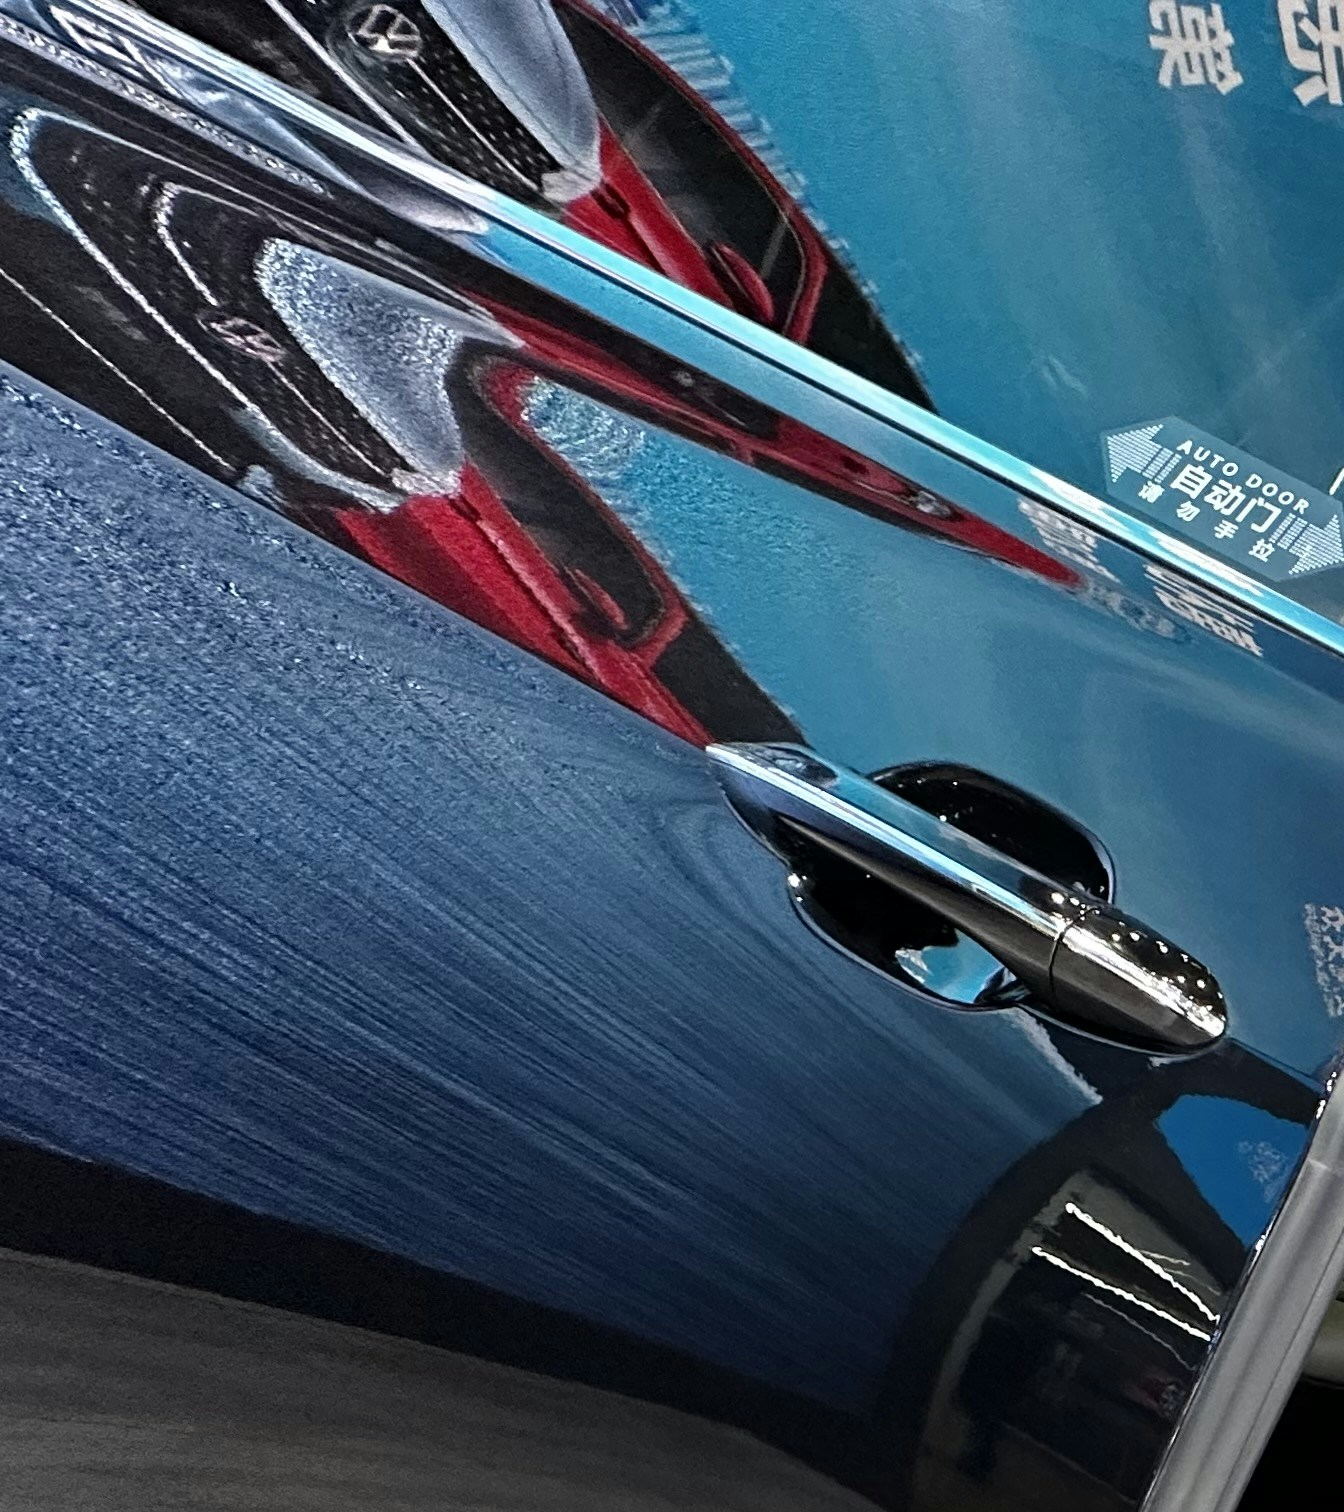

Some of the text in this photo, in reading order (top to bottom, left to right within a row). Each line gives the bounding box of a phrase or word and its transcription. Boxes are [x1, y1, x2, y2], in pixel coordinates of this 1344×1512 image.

[1170, 463, 1282, 533] 自动门
[1176, 439, 1310, 515] AUTO DOOR
[1138, 480, 1276, 562] 请勿手拉
